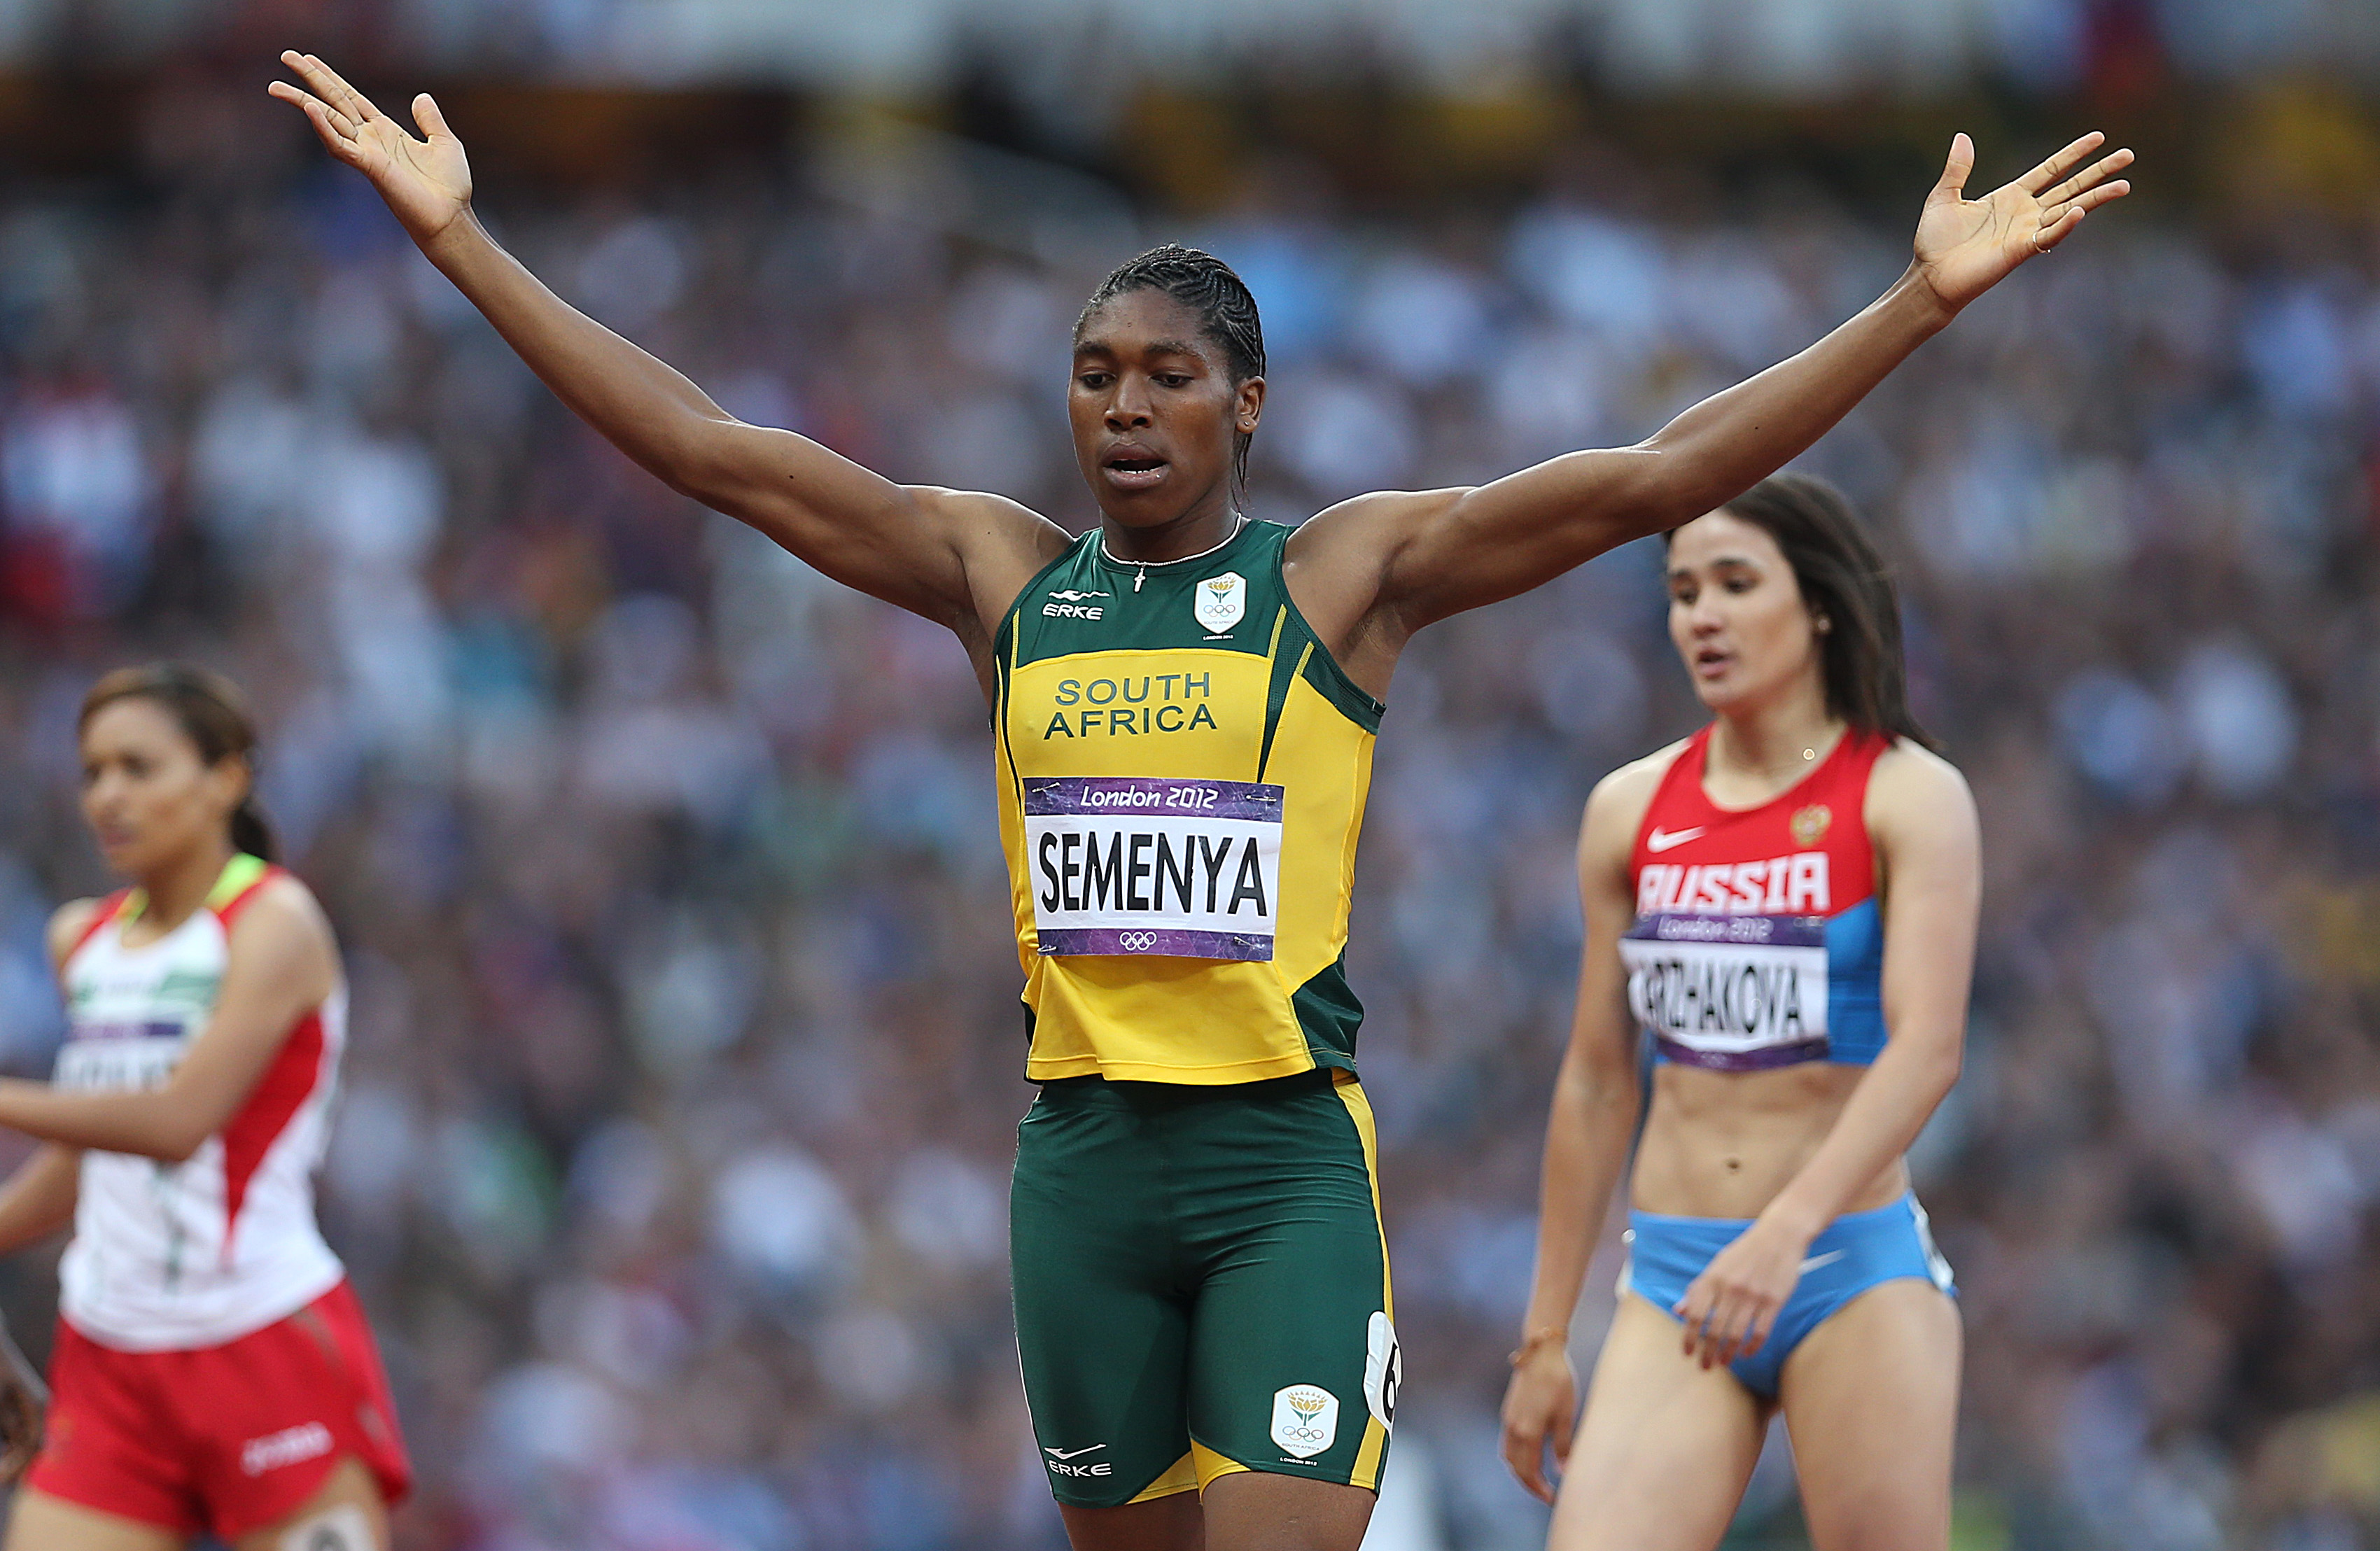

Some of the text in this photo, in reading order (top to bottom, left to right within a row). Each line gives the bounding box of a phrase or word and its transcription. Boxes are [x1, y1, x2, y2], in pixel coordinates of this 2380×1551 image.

[1042, 603, 1104, 620] ERKE
[1055, 672, 1210, 706] SOUTH
[1043, 703, 1218, 741] AFRICA
[1081, 785, 1219, 809] London 2012
[1039, 831, 1268, 917] SEMENYA
[1637, 852, 1831, 915] RUSSIA
[1049, 1459, 1112, 1477] ERKE
